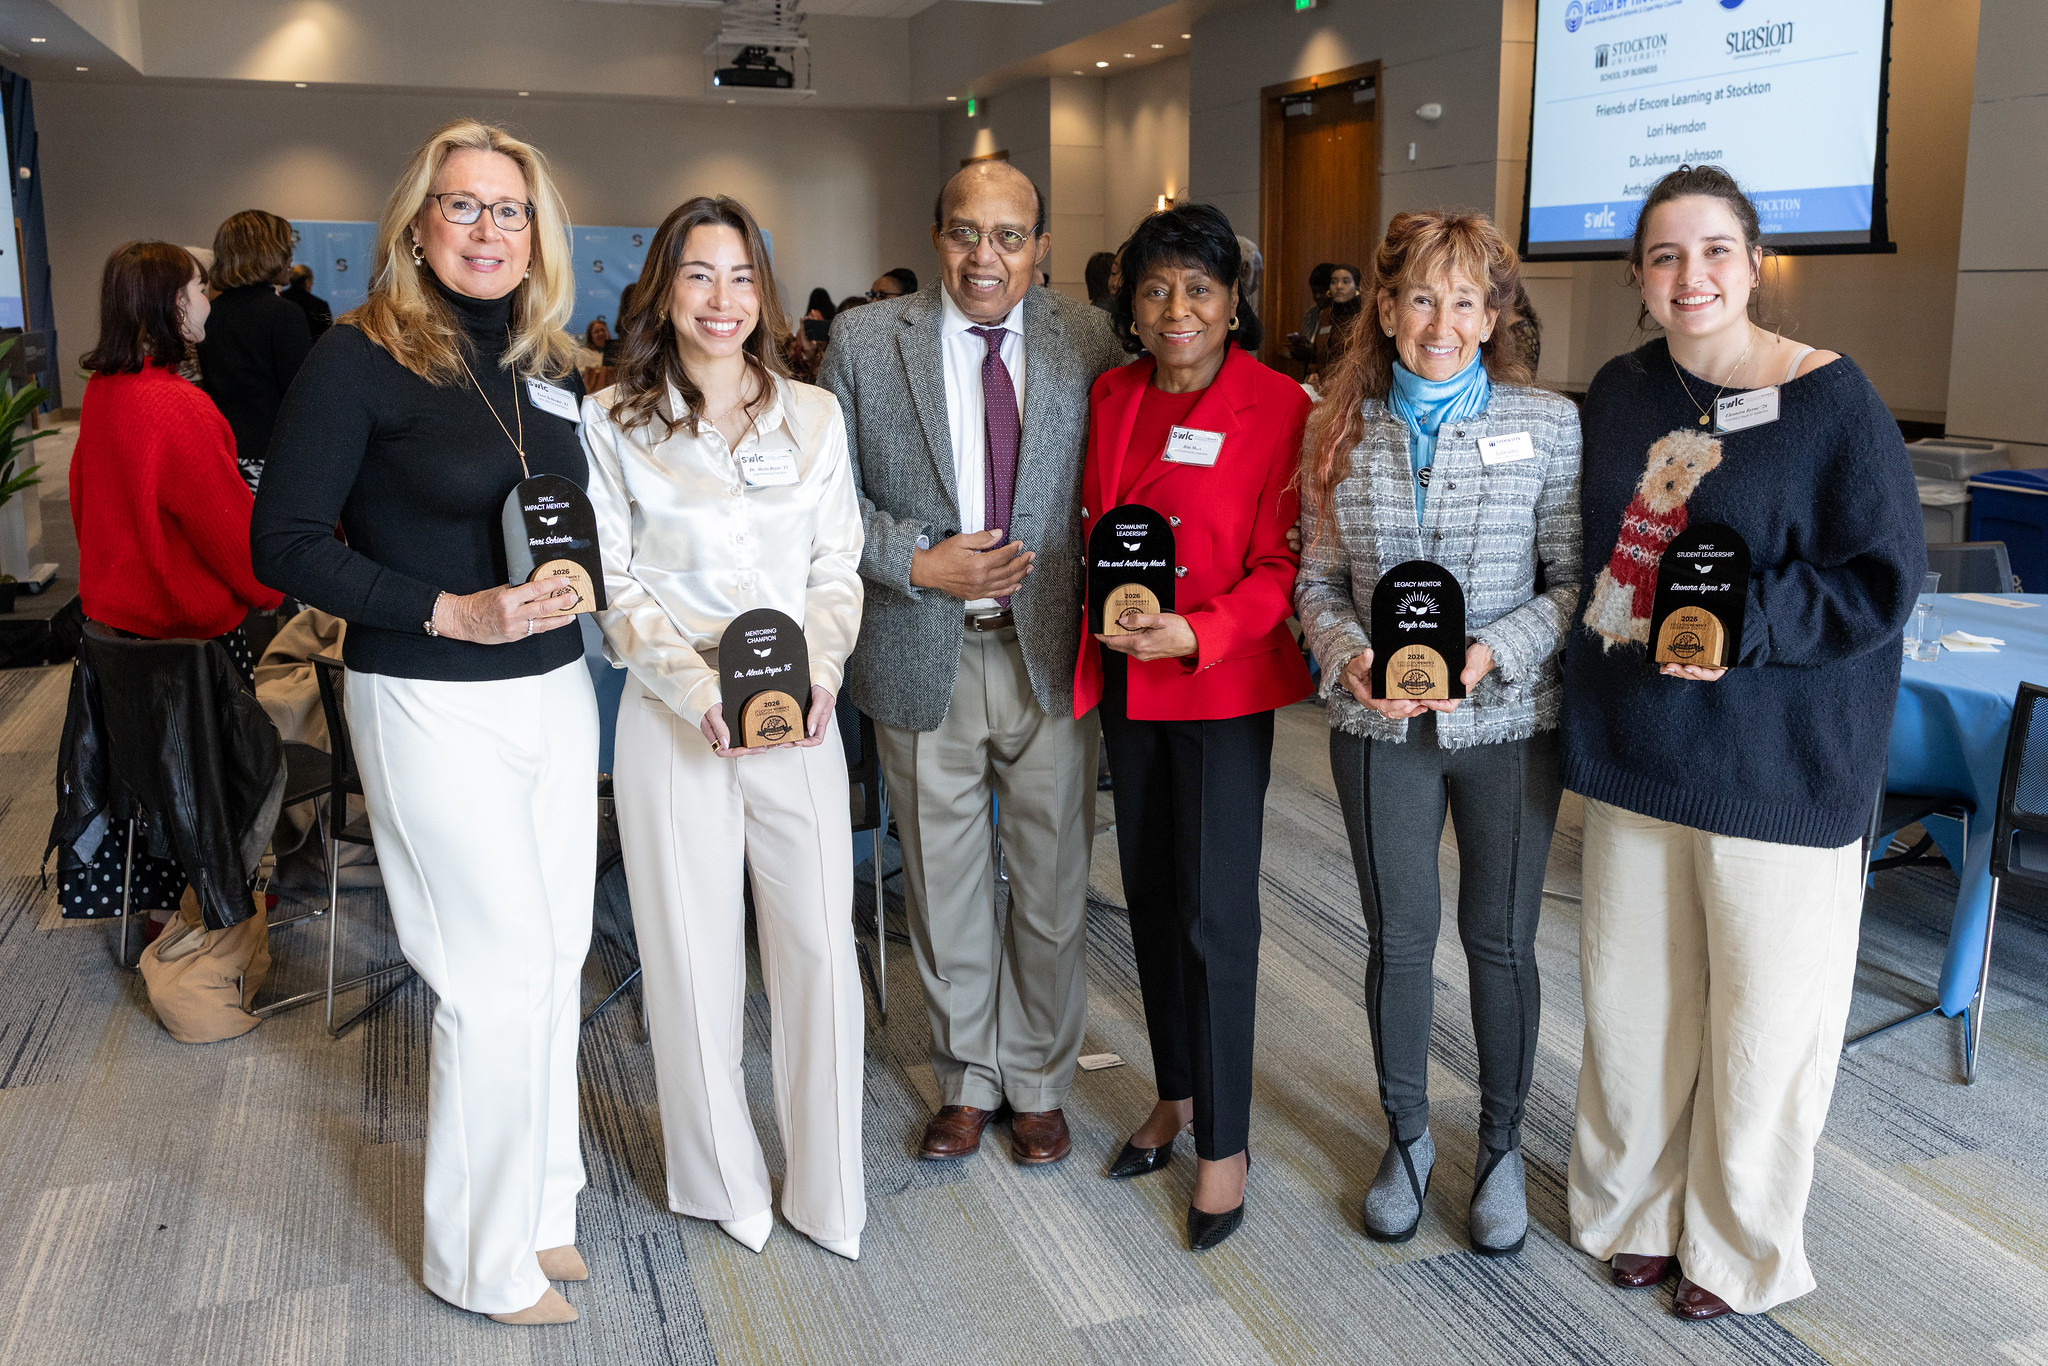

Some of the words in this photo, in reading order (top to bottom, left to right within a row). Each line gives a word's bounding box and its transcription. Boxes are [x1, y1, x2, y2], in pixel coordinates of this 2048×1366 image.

[1726, 19, 1794, 55] suasion
[1612, 33, 1668, 56] STOCKTON
[1611, 49, 1667, 66] UNIVERSITY
[1600, 71, 1620, 82] SCHOOL
[1622, 69, 1630, 77] OF
[1631, 64, 1658, 77] BUSINESS
[1596, 102, 1626, 117] Friends
[1628, 98, 1638, 112] of
[1639, 97, 1669, 111] Encore
[1672, 90, 1712, 106] Learning
[1714, 89, 1724, 100] at
[1726, 81, 1771, 98] Stockton
[1647, 124, 1664, 138] Lori
[1666, 119, 1706, 136] Herndon
[1630, 155, 1641, 168] Dr.
[1643, 151, 1681, 166] Johanna
[1683, 148, 1723, 163] Johnson
[1584, 204, 1616, 229] swlc
[1719, 397, 1744, 411] swlc
[1172, 431, 1194, 441] swlc
[741, 453, 765, 464] swlc
[538, 495, 554, 503] SWLC
[524, 503, 545, 512] IMPACT
[546, 502, 570, 511] MENTOR
[529, 538, 545, 547] Terri
[1698, 543, 1714, 551] SWLC
[1097, 560, 1111, 568] Rita
[1111, 560, 1124, 568] and
[1124, 559, 1149, 570] Anthony
[1149, 559, 1167, 567] Mack
[552, 568, 570, 576] 2026
[1670, 583, 1699, 591] Eleonora
[1699, 583, 1719, 594] Byrne
[1398, 620, 1418, 632] Gayle
[1419, 620, 1438, 629] Gross
[745, 627, 777, 637] MENTORING
[747, 635, 777, 644] CHAMPION
[734, 670, 745, 679] Dr.
[746, 667, 764, 677] Alexis
[765, 665, 783, 677] Reyes
[763, 700, 780, 708] 2026
